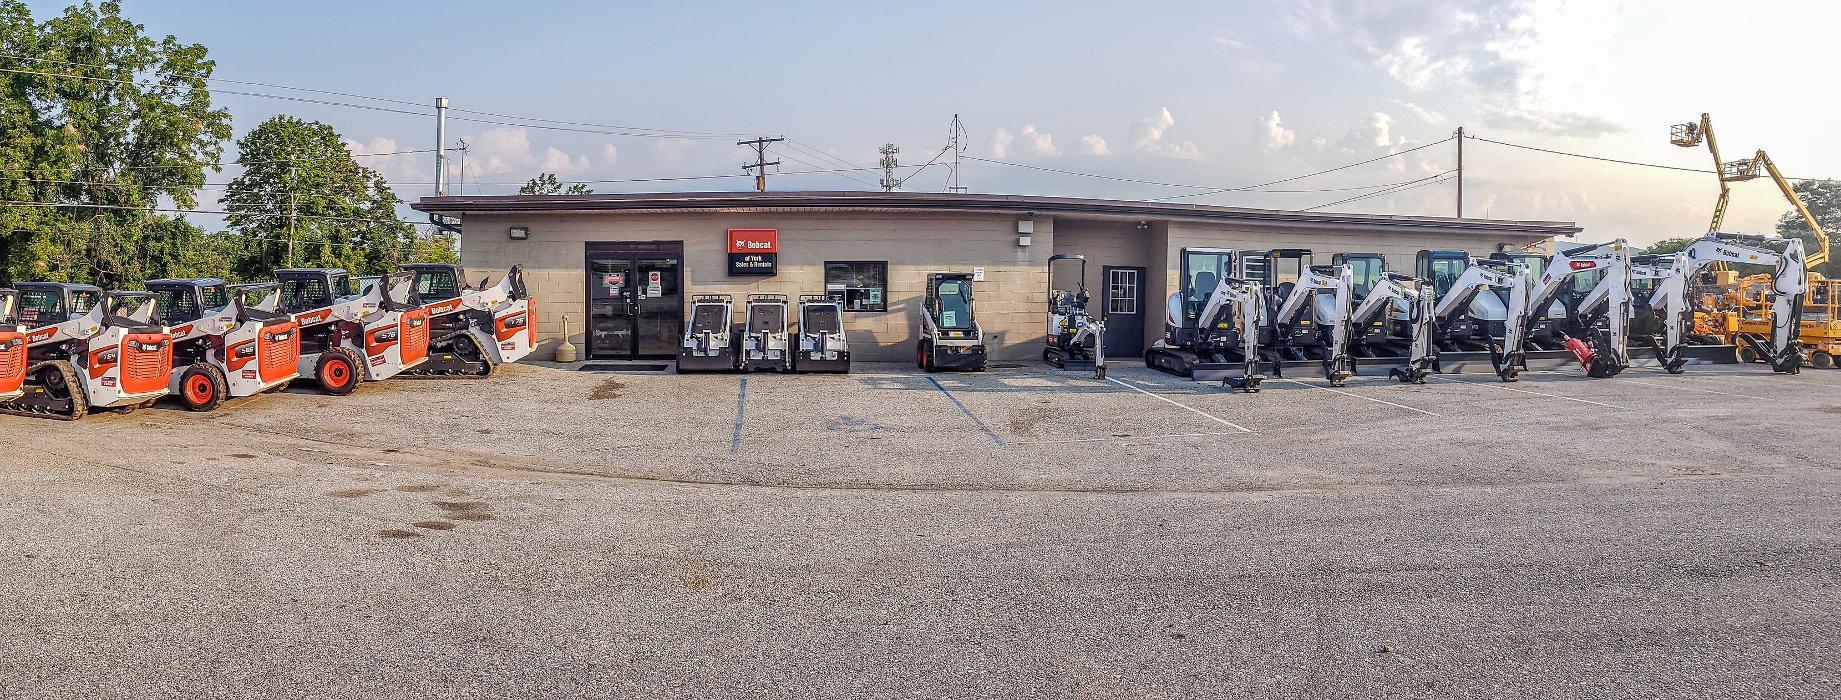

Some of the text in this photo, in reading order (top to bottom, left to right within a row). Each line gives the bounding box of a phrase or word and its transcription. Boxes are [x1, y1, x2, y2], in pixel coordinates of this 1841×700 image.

[431, 304, 453, 315] Bobcat
[300, 314, 321, 326] Bobcat
[381, 331, 396, 339] S76
